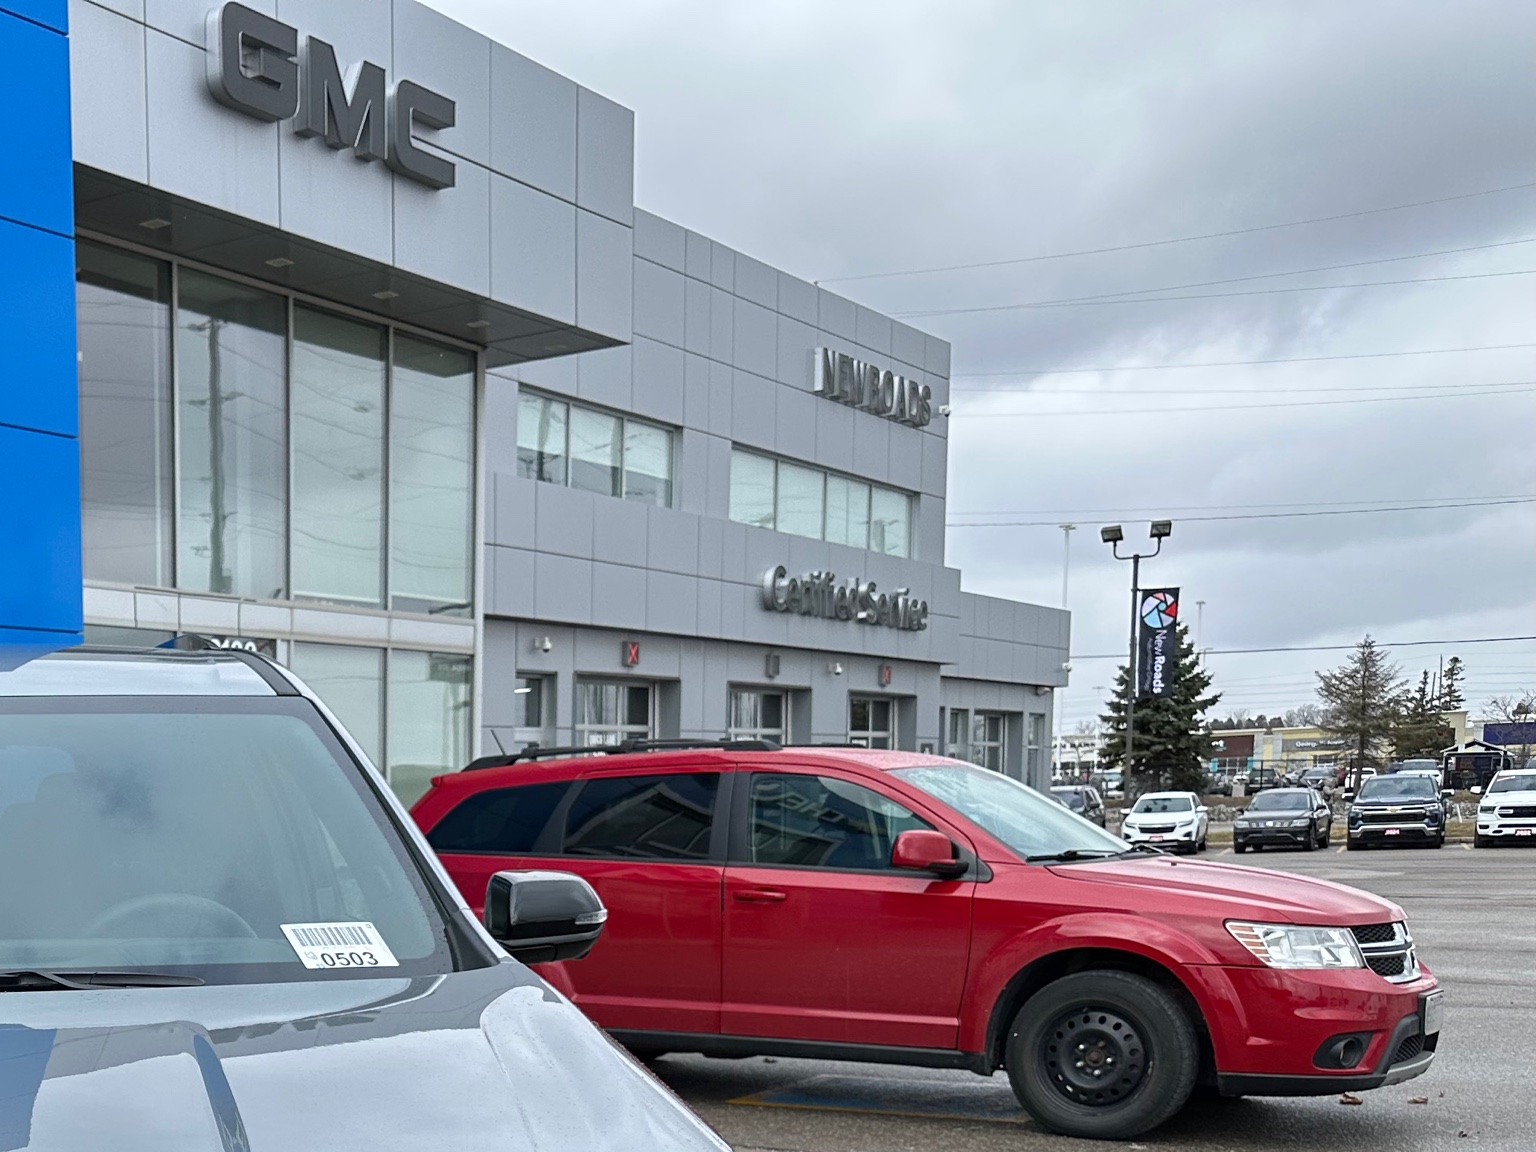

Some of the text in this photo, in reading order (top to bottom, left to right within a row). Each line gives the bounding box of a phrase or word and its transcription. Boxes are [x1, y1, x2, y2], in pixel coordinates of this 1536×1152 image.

[207, 1, 456, 190] GMC
[814, 347, 931, 428] NEWROADS
[764, 565, 928, 631] Certified Service
[320, 951, 379, 967] 0503
